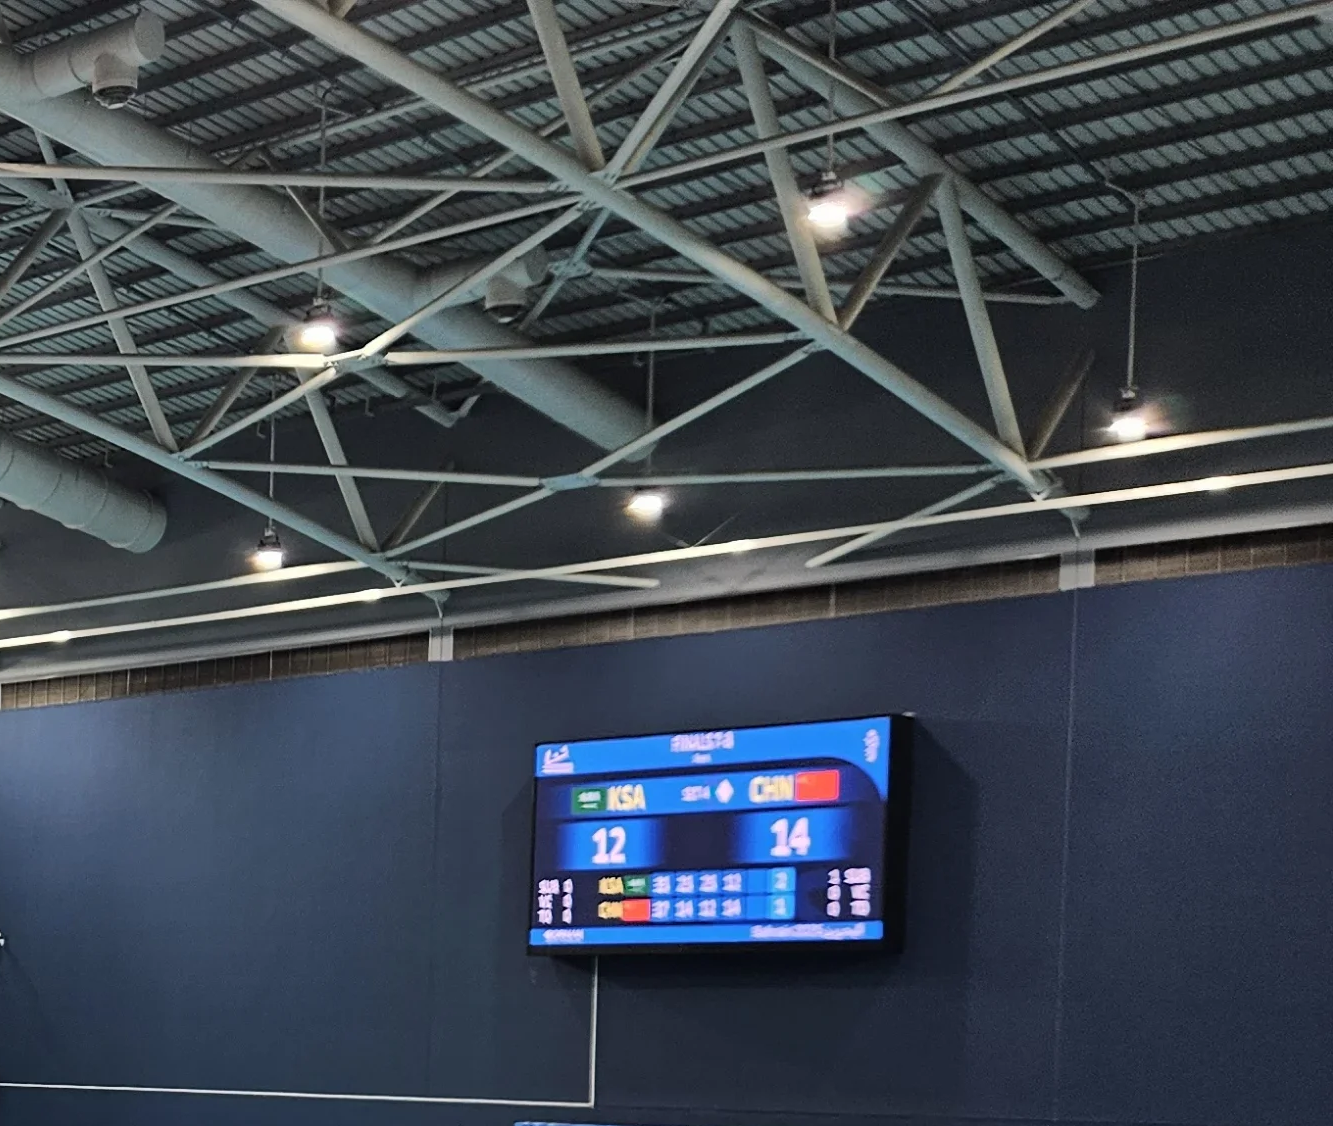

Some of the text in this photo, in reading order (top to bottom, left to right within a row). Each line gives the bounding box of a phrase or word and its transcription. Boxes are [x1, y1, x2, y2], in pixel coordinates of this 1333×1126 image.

[607, 784, 646, 811] KSA
[749, 775, 795, 803] CHN
[591, 826, 627, 864] 12
[770, 817, 811, 857] 14
